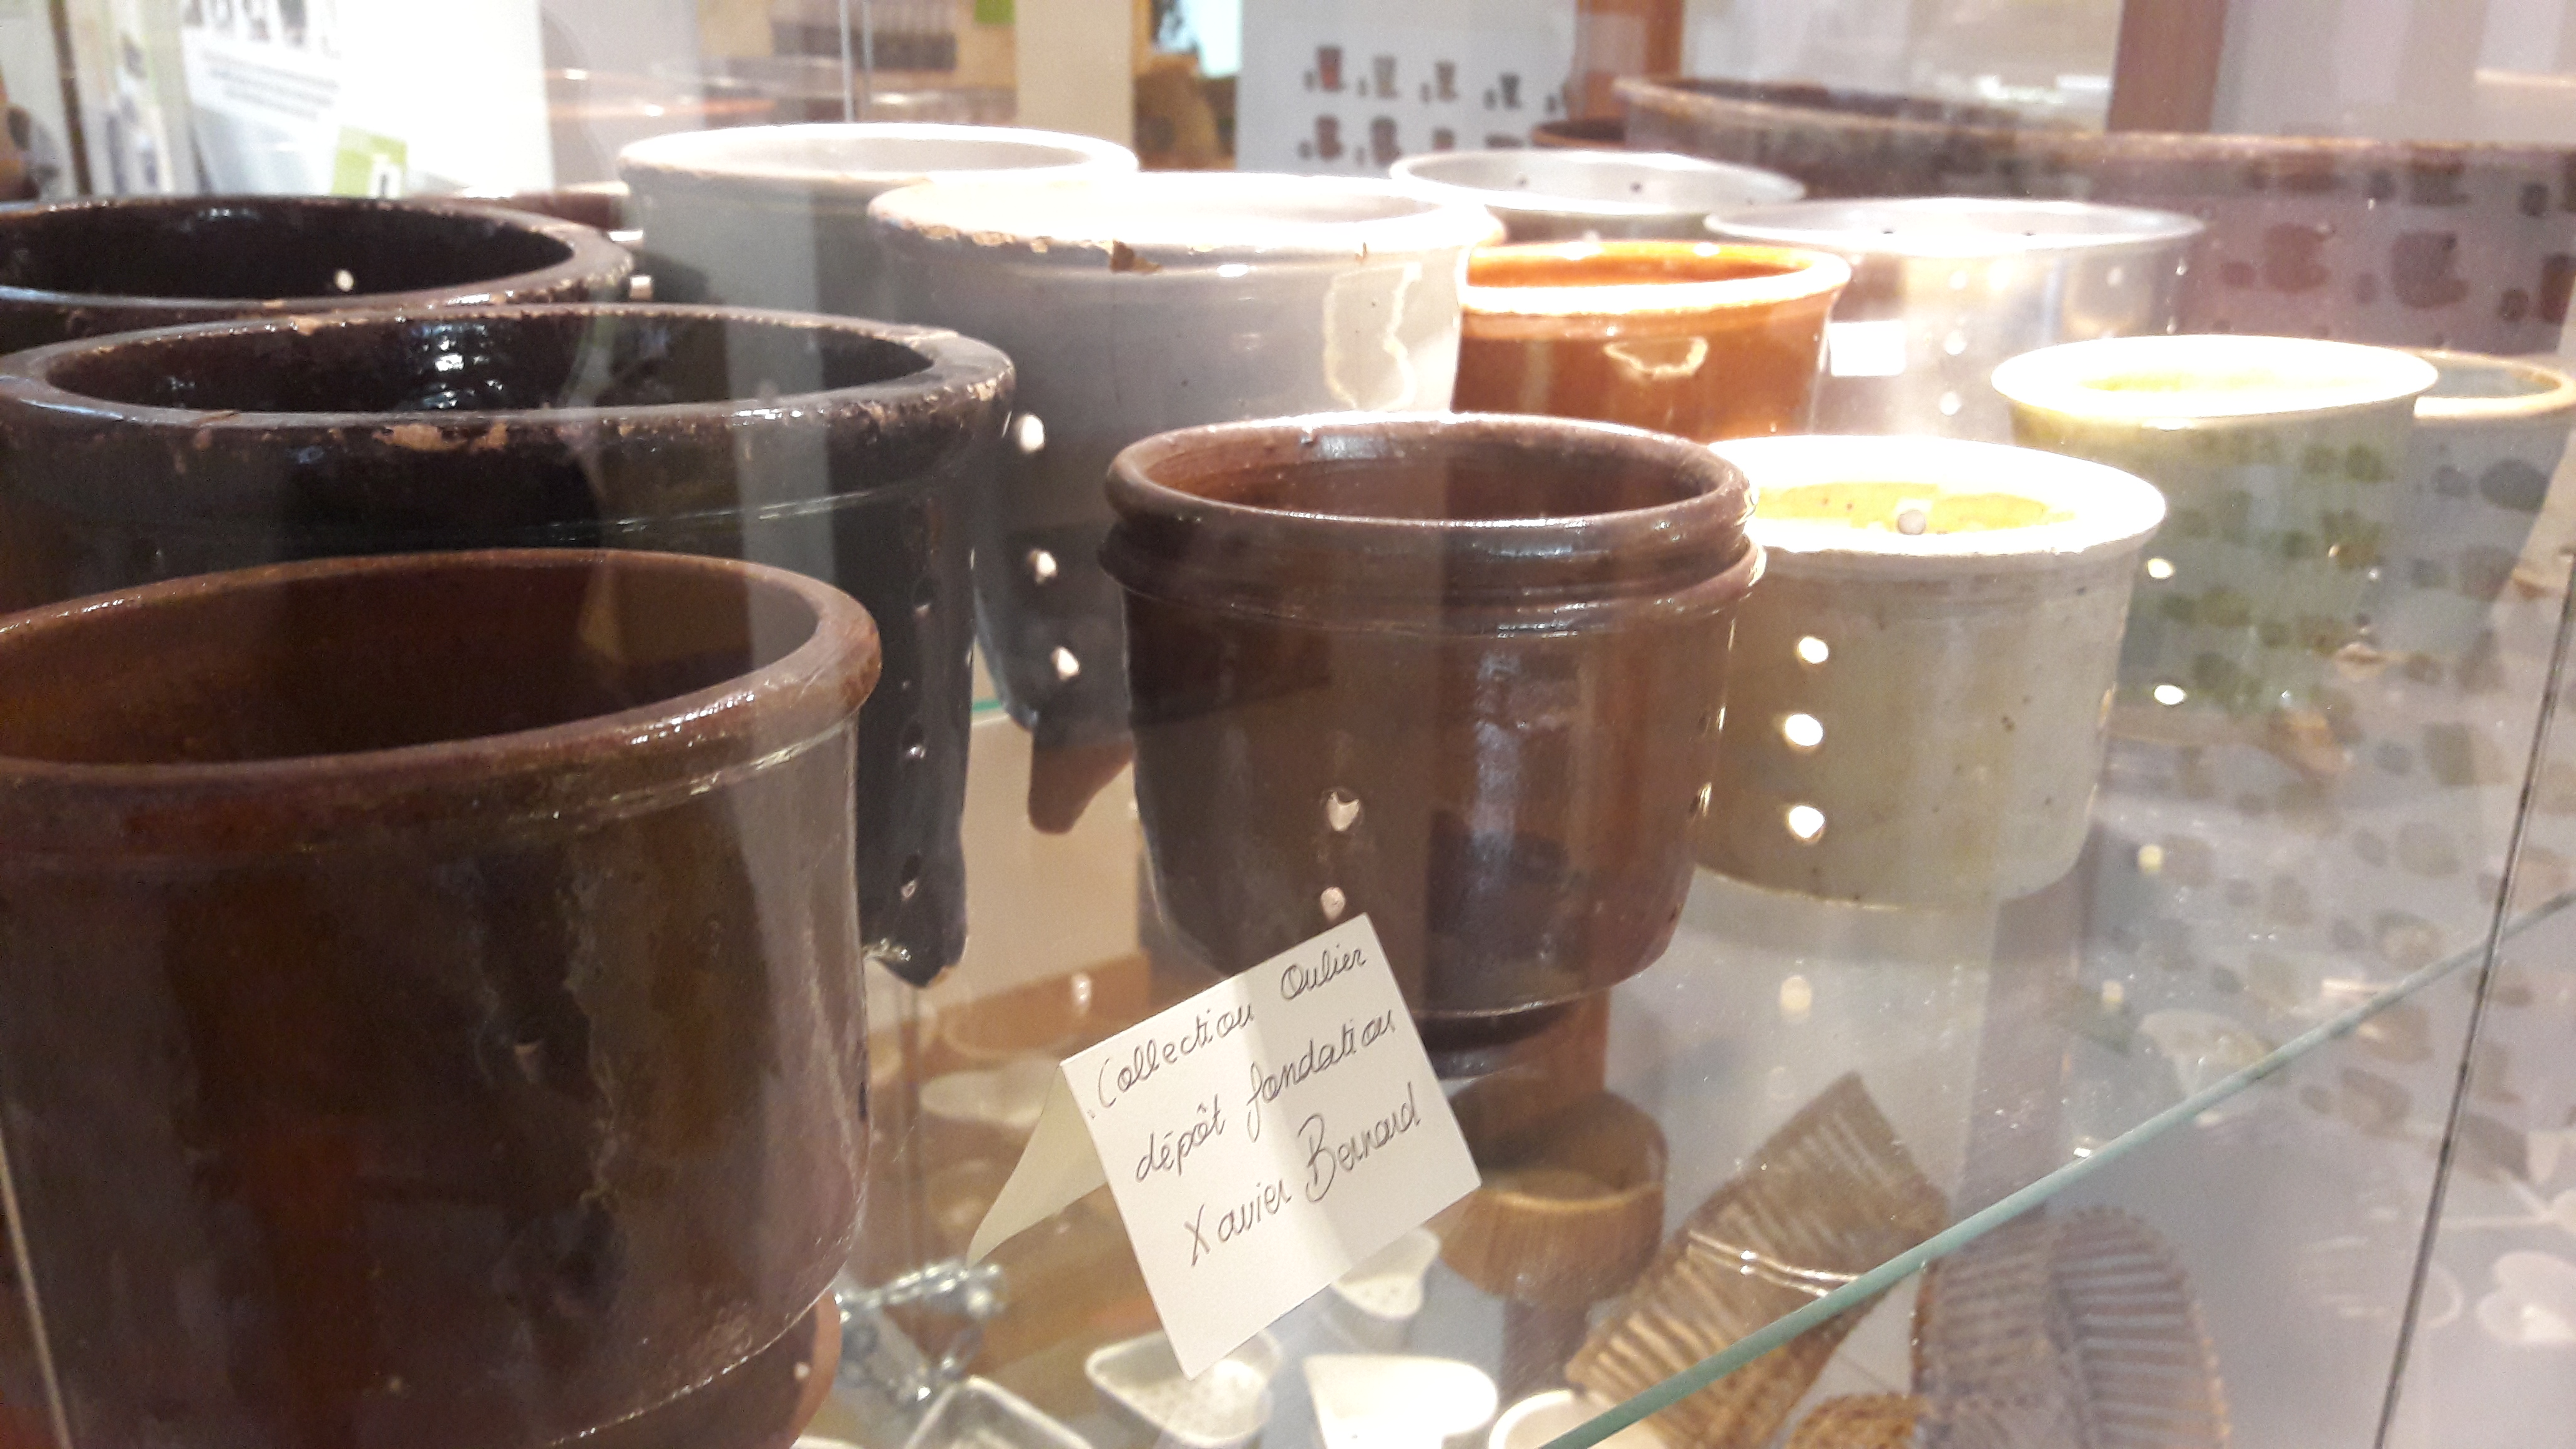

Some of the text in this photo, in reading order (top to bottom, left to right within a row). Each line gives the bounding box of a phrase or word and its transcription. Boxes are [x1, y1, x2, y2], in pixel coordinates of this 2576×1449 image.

[1098, 1003, 1254, 1108] Collection
[1136, 1009, 1395, 1181] dépôt fondation
[1184, 1081, 1422, 1266] Xavier Bernard
